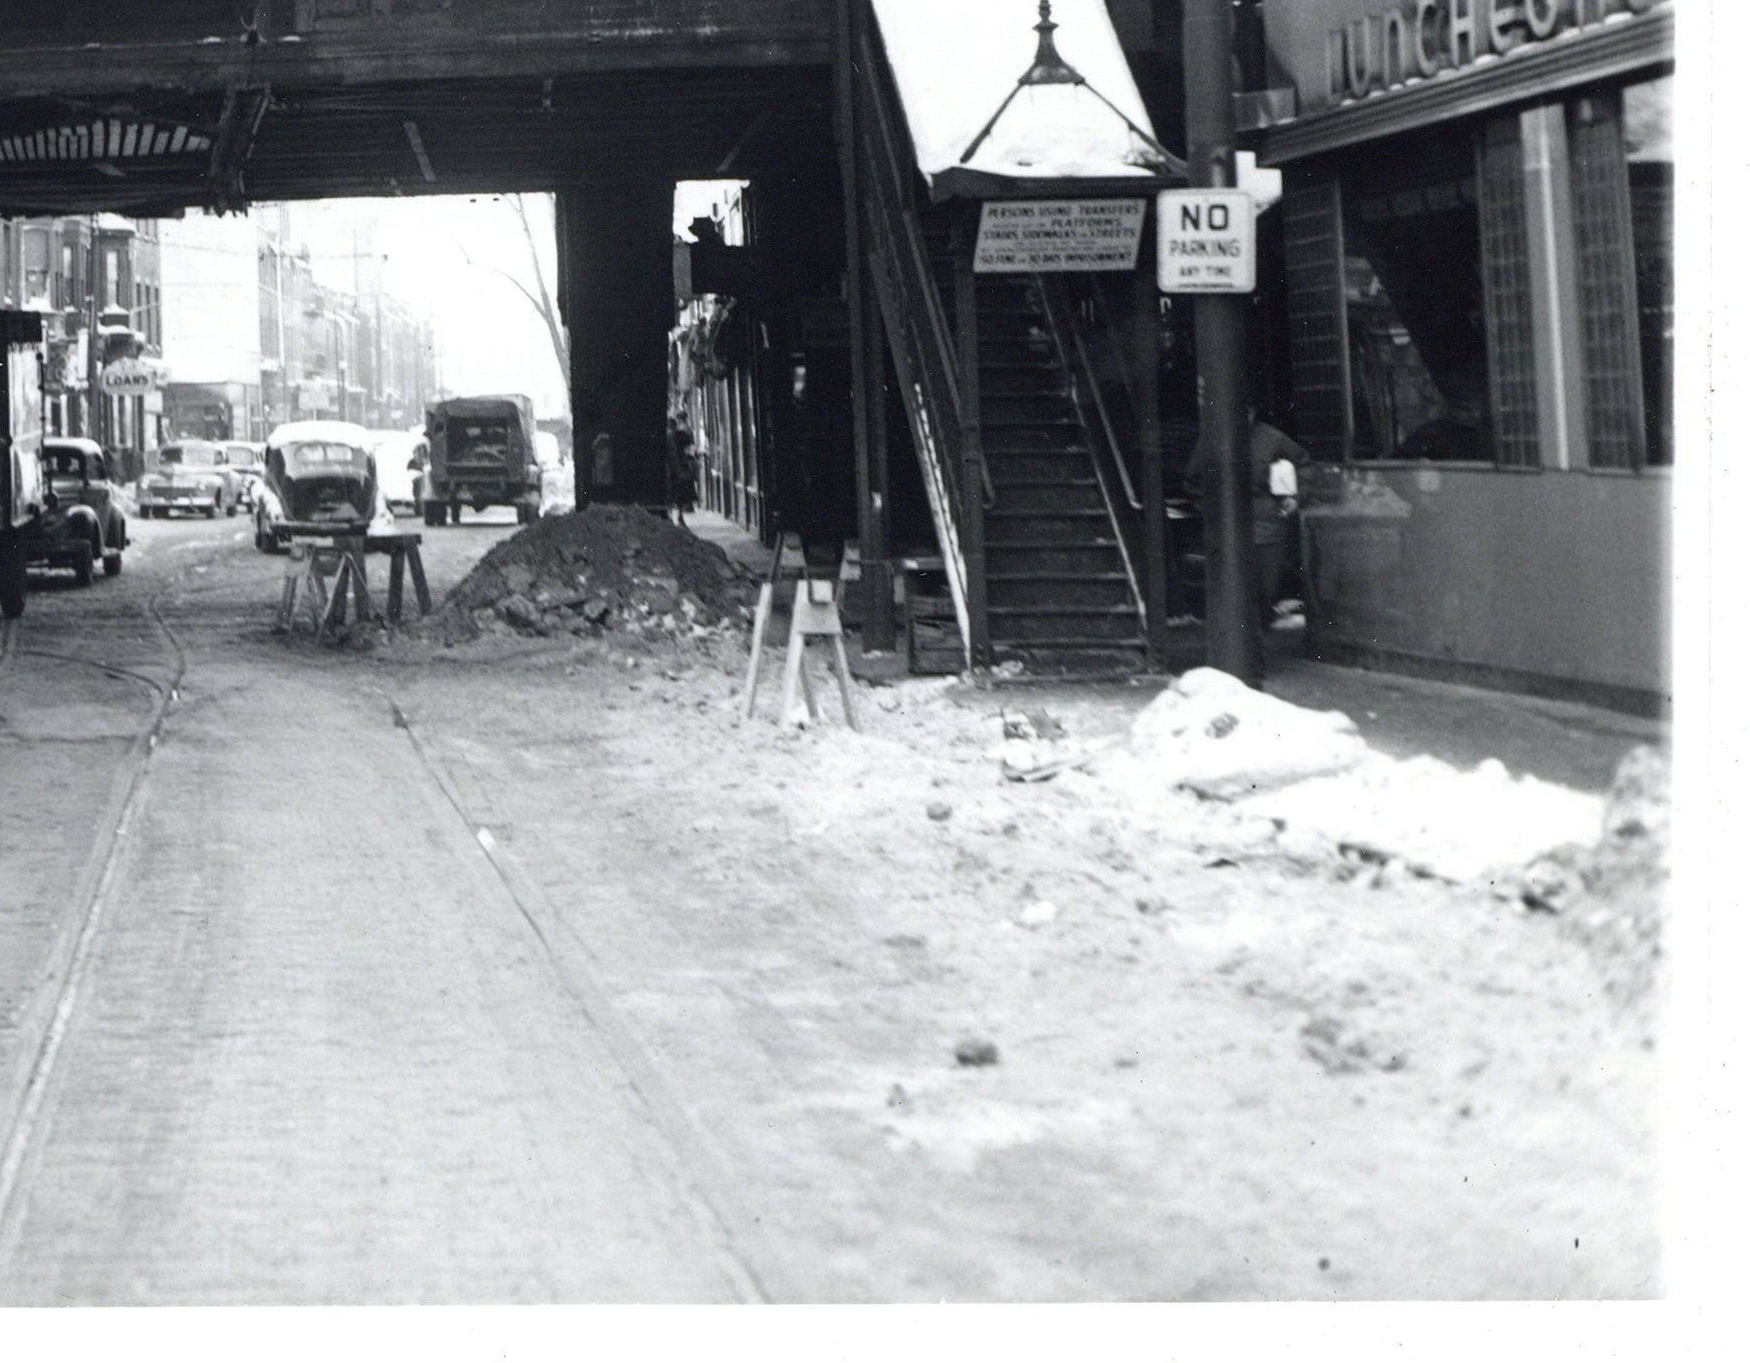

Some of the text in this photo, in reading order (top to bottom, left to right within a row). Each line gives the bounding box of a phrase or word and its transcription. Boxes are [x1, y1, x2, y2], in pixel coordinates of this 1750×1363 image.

[988, 207, 1035, 217] PERSONS
[1079, 205, 1139, 216] TRANSFERS
[1051, 218, 1122, 228] PLATFORMS
[1181, 204, 1229, 231] NO
[1090, 228, 1136, 238] STREETS
[1170, 239, 1241, 257] PARKING
[1064, 252, 1132, 263] IMPRISONMENT
[1179, 265, 1232, 276] ANY TIME
[106, 375, 149, 387] LOANS
